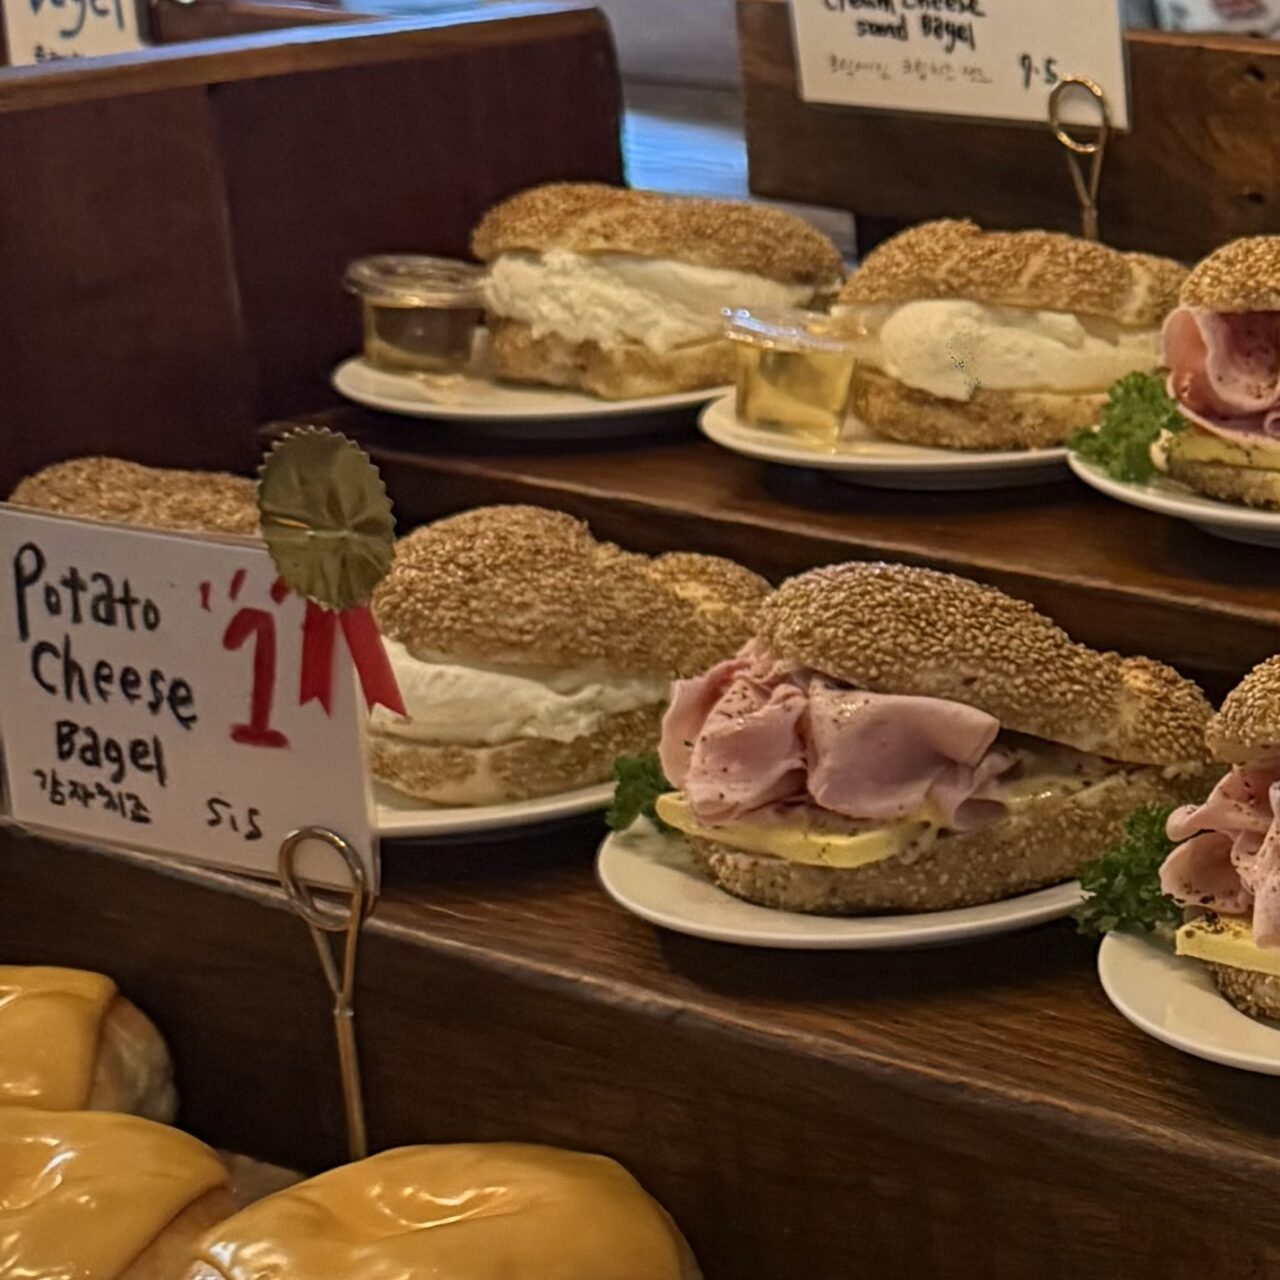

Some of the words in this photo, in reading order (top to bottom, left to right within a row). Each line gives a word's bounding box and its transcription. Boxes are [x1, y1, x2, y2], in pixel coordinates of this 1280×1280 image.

[13, 541, 162, 642] Potato
[31, 633, 199, 732] Cheese
[55, 720, 168, 788] Bagel
